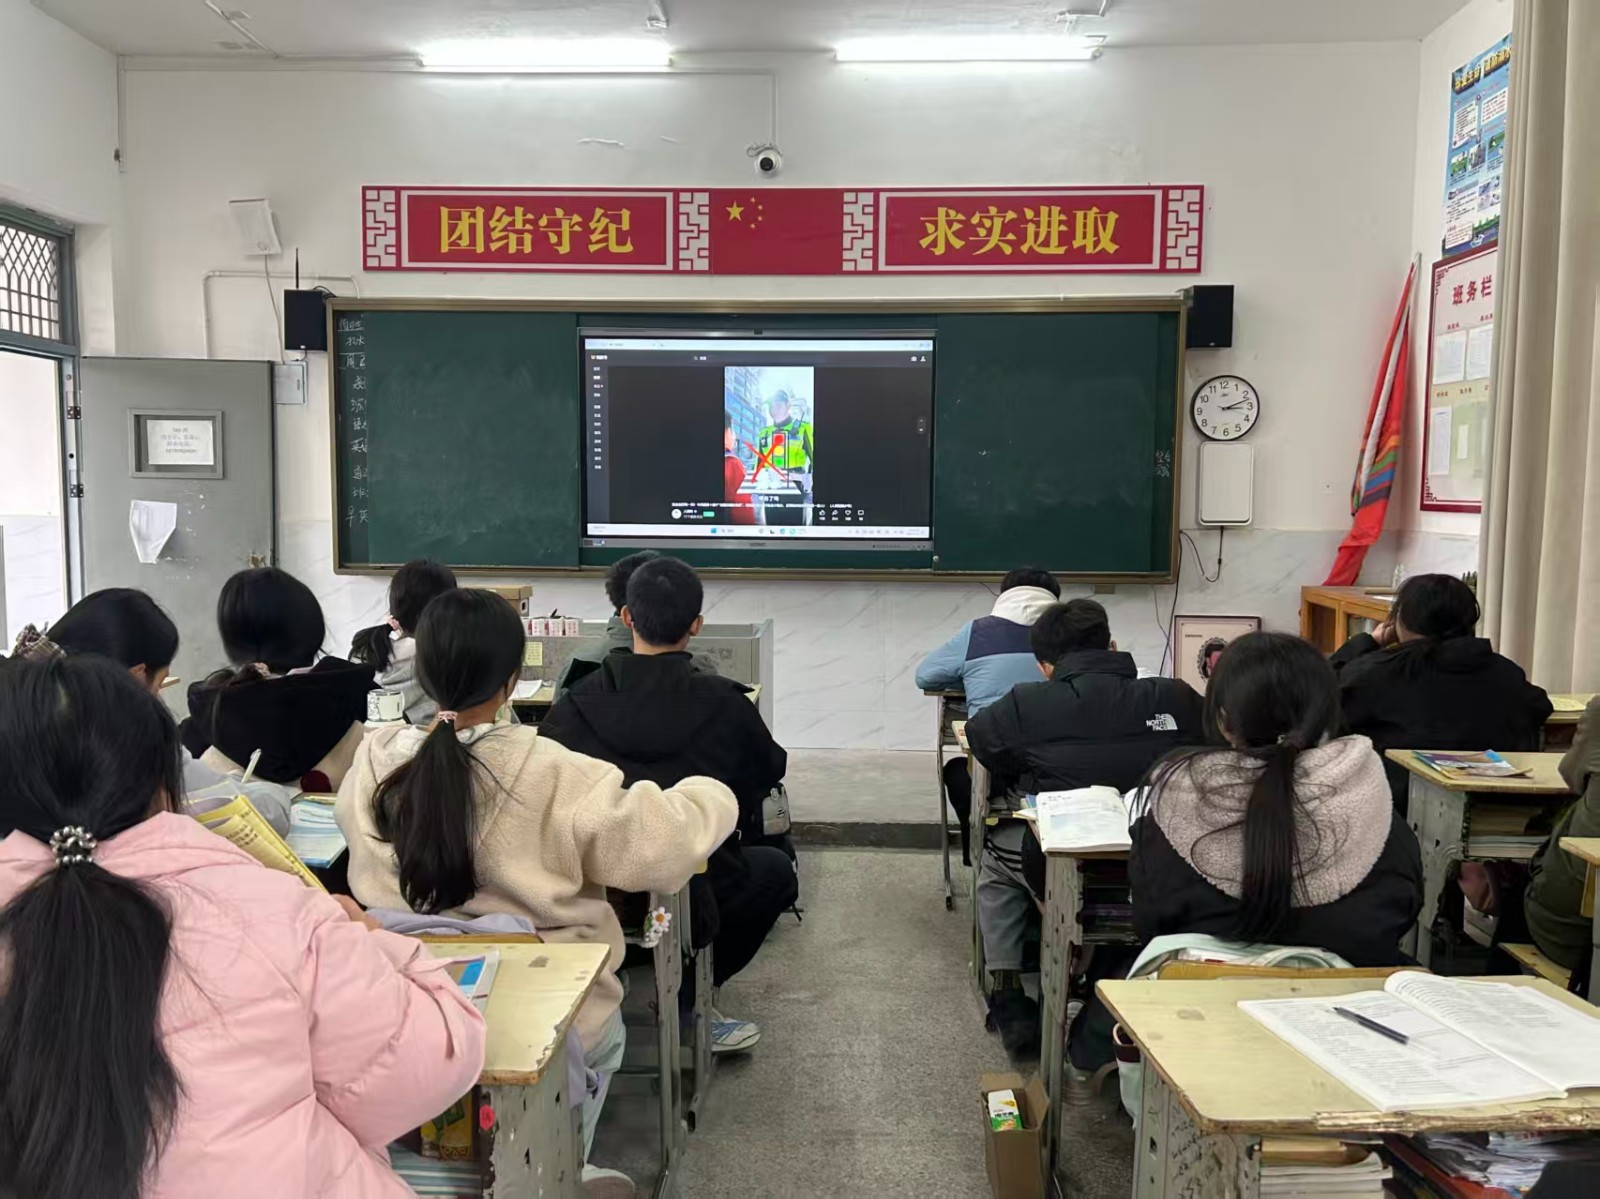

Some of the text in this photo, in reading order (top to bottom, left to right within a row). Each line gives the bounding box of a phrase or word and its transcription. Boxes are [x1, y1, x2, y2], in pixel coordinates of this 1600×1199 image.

[440, 205, 634, 255] 团结守纪
[919, 205, 1120, 256] 求实进取
[1452, 275, 1493, 306] 班务栏
[1220, 380, 1229, 389] 12
[1234, 383, 1239, 391] 1
[1209, 385, 1217, 394] 11
[1200, 395, 1209, 403] 10
[1242, 390, 1249, 399] 2
[1247, 401, 1253, 410] 3
[1196, 407, 1203, 415] 9
[1201, 418, 1207, 427] 8
[1243, 414, 1250, 423] 4
[1211, 426, 1217, 435] 7
[1222, 428, 1229, 436] 6
[1235, 424, 1241, 432] 5
